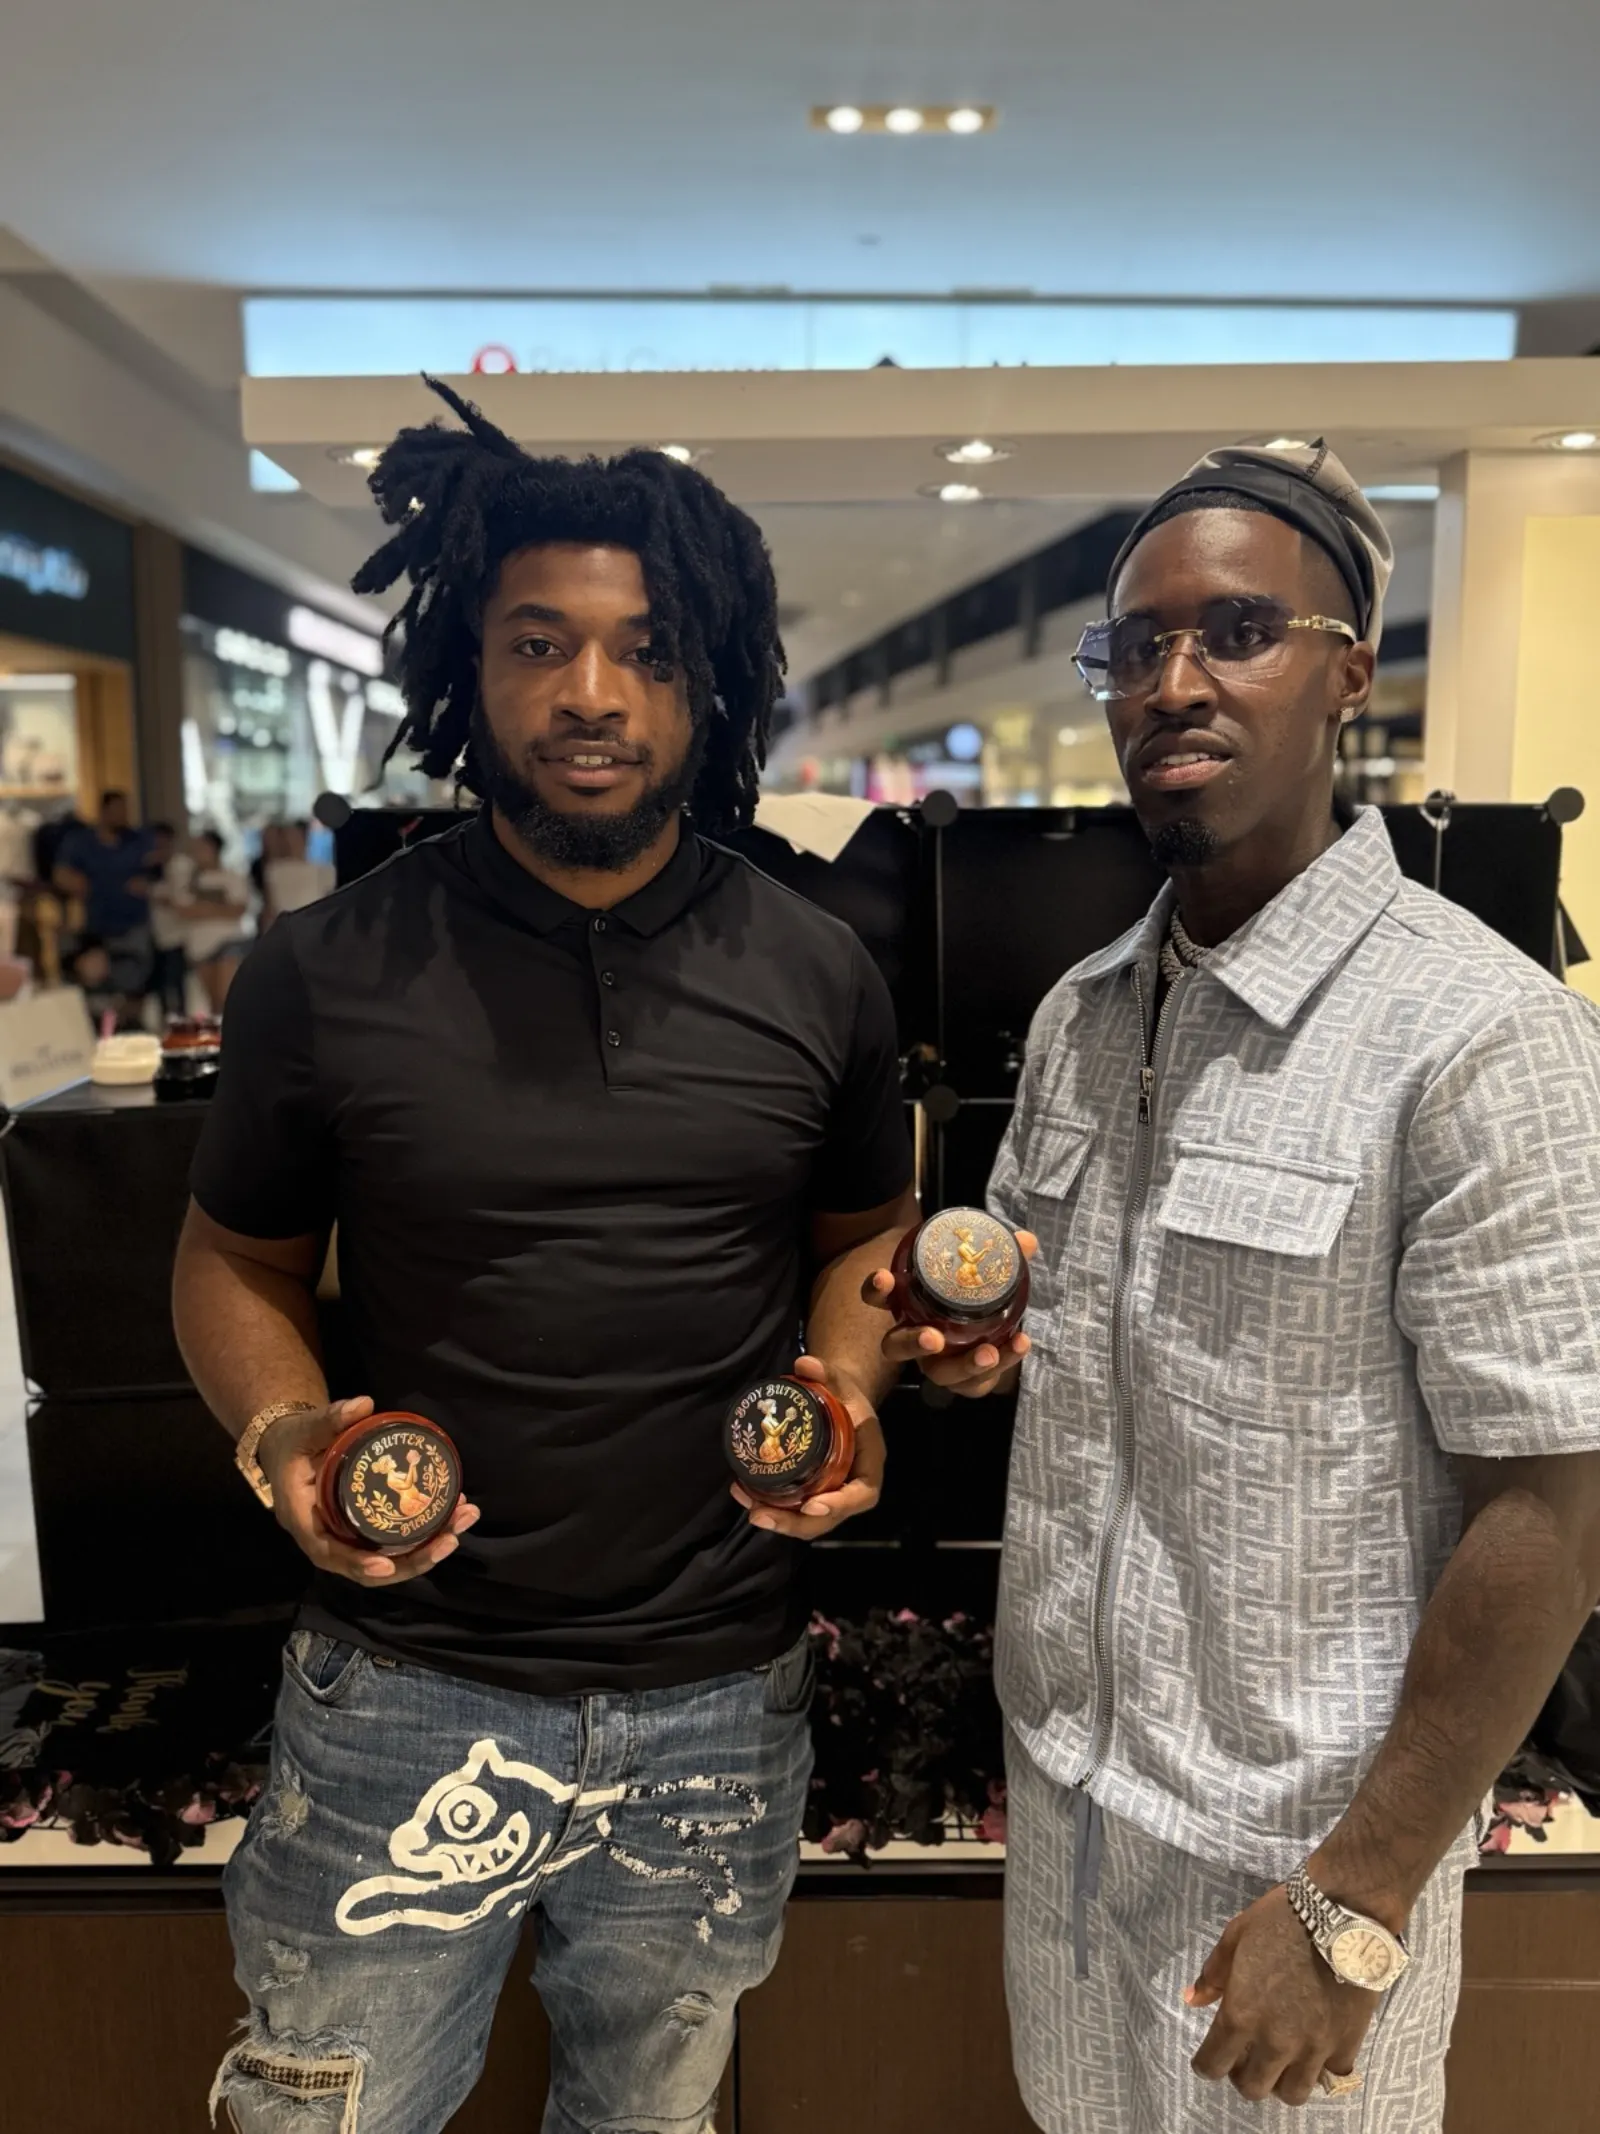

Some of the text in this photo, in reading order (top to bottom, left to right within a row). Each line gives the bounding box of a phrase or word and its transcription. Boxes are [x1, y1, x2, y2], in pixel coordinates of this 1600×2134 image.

[735, 1384, 809, 1418] BODY BUTTER
[350, 1433, 426, 1493] BODY BUTTER
[749, 1458, 797, 1475] BUREAU
[400, 1496, 448, 1537] BUREAU
